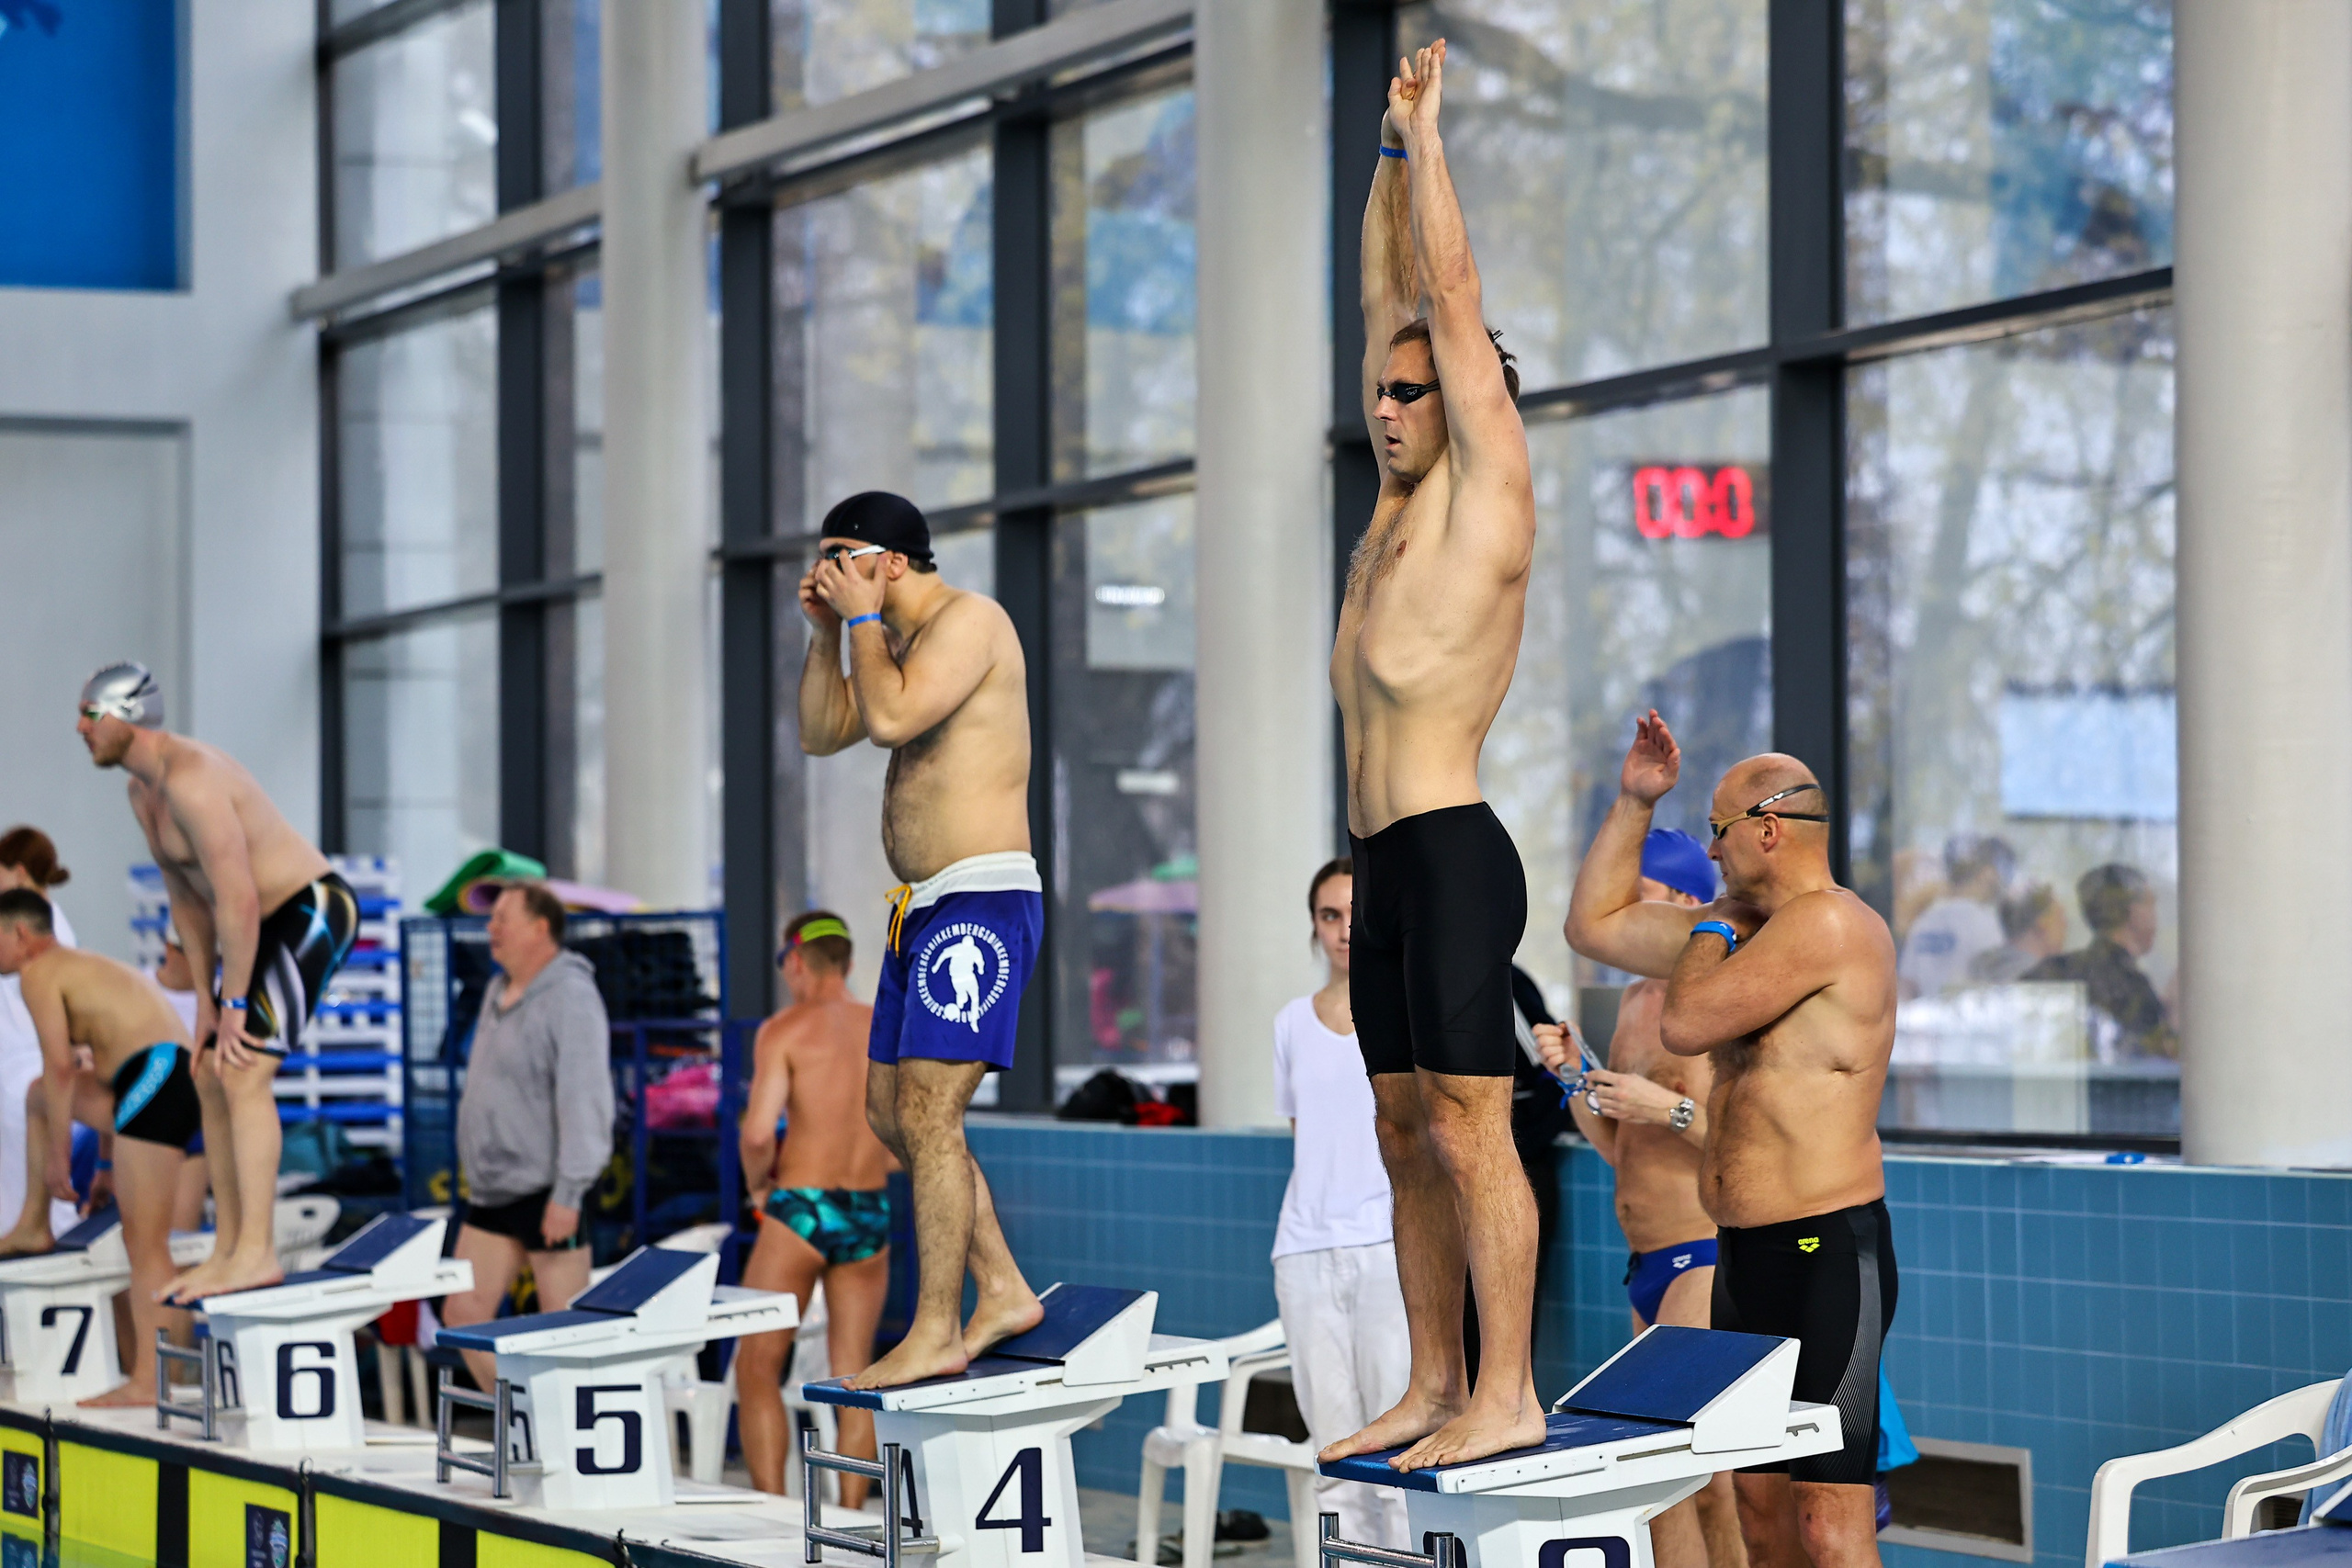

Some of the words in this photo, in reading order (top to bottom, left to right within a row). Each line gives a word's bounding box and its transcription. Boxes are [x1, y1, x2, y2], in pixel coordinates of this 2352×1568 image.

[1798, 1236, 1819, 1245] arena
[41, 1306, 94, 1375] 7
[277, 1341, 335, 1419] 6
[576, 1384, 641, 1475] 5
[976, 1447, 1051, 1552] 4
